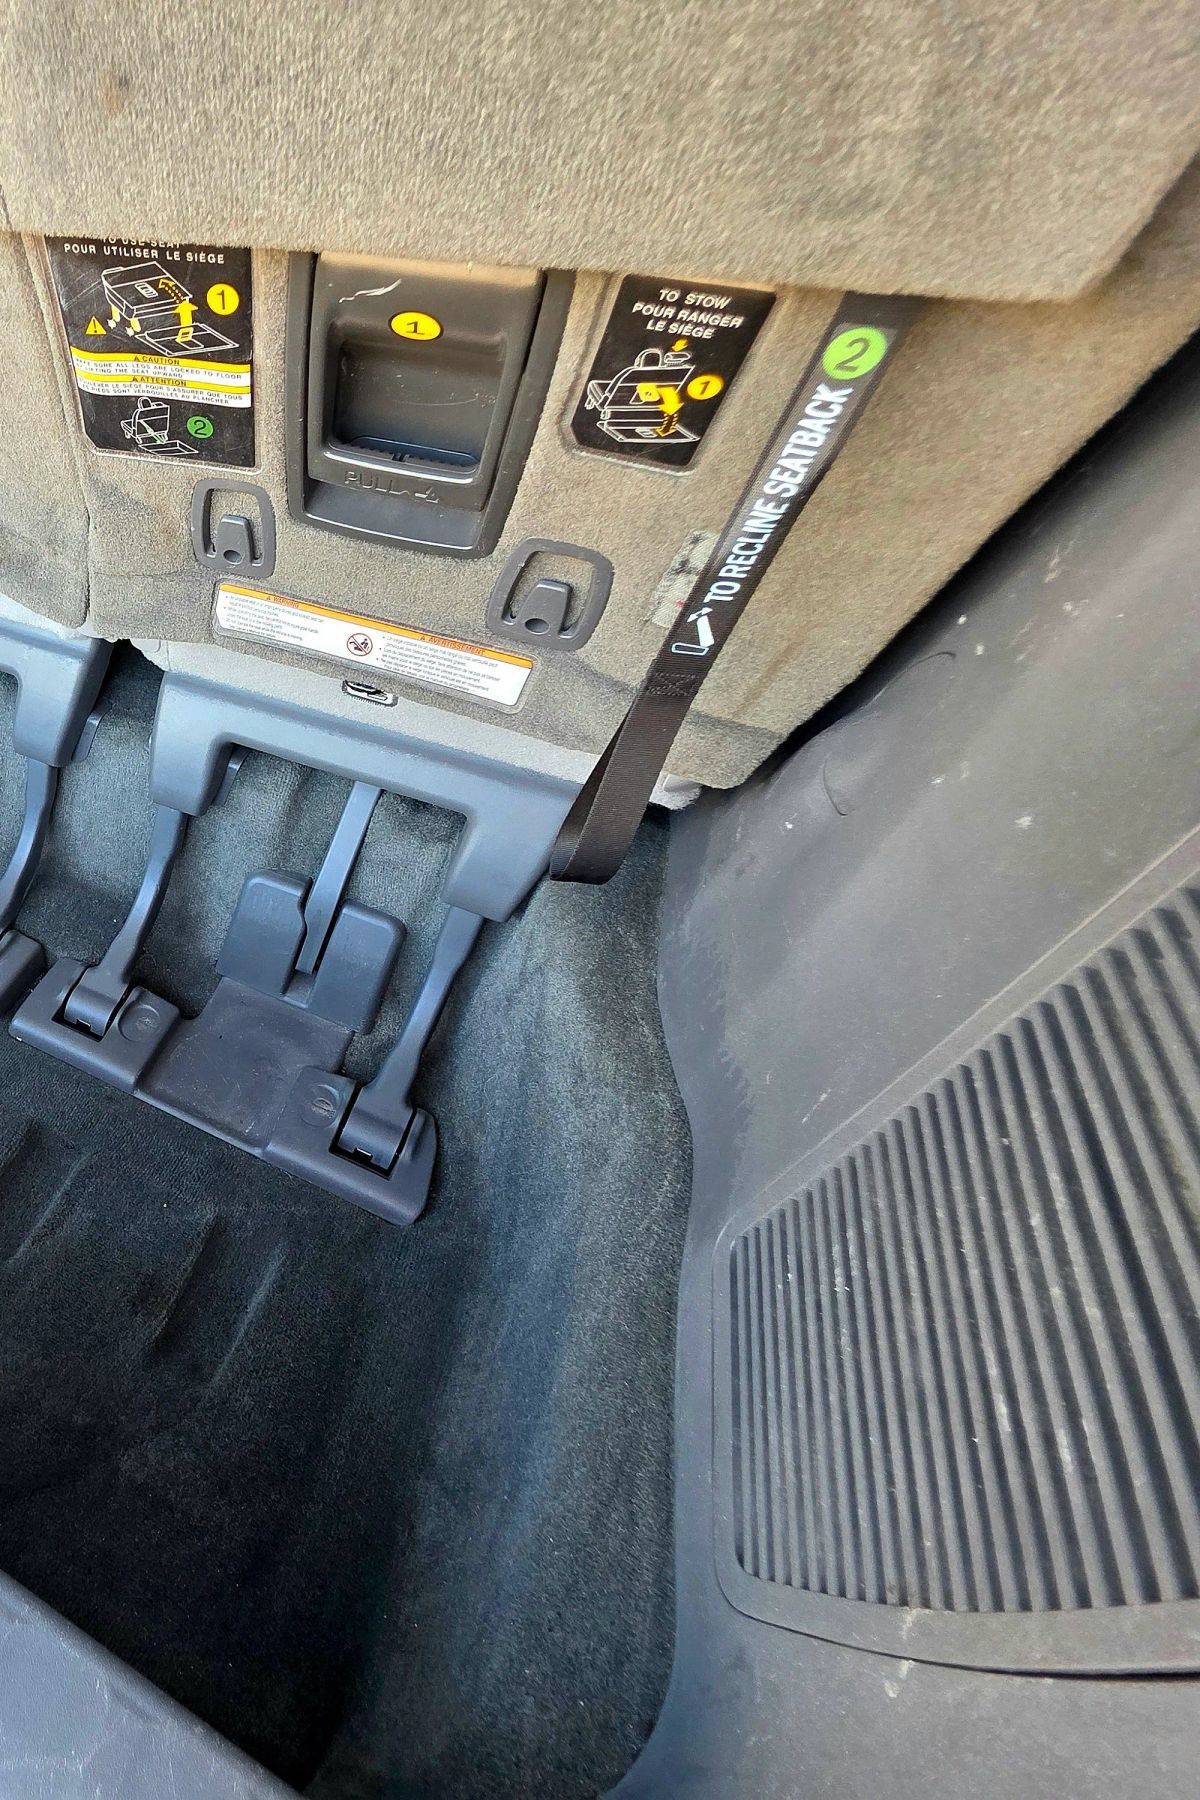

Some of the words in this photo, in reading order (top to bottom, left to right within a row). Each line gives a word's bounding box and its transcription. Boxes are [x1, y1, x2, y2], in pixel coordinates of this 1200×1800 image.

[64, 243, 97, 254] POUR
[103, 247, 159, 259] UTILISER
[166, 251, 181, 261] LE
[659, 288, 680, 303] TO
[684, 293, 732, 310] STOW
[632, 301, 676, 319] POUR
[676, 309, 745, 329] RANGER
[646, 318, 668, 332] LE
[142, 355, 180, 366] CAUTION
[170, 367, 201, 375] LOCKED
[140, 376, 187, 388] ATTENTION
[224, 393, 243, 401] TOUS
[703, 580, 741, 603] TO
[722, 498, 790, 580] RECLINE
[762, 383, 854, 499] SEATBACK
